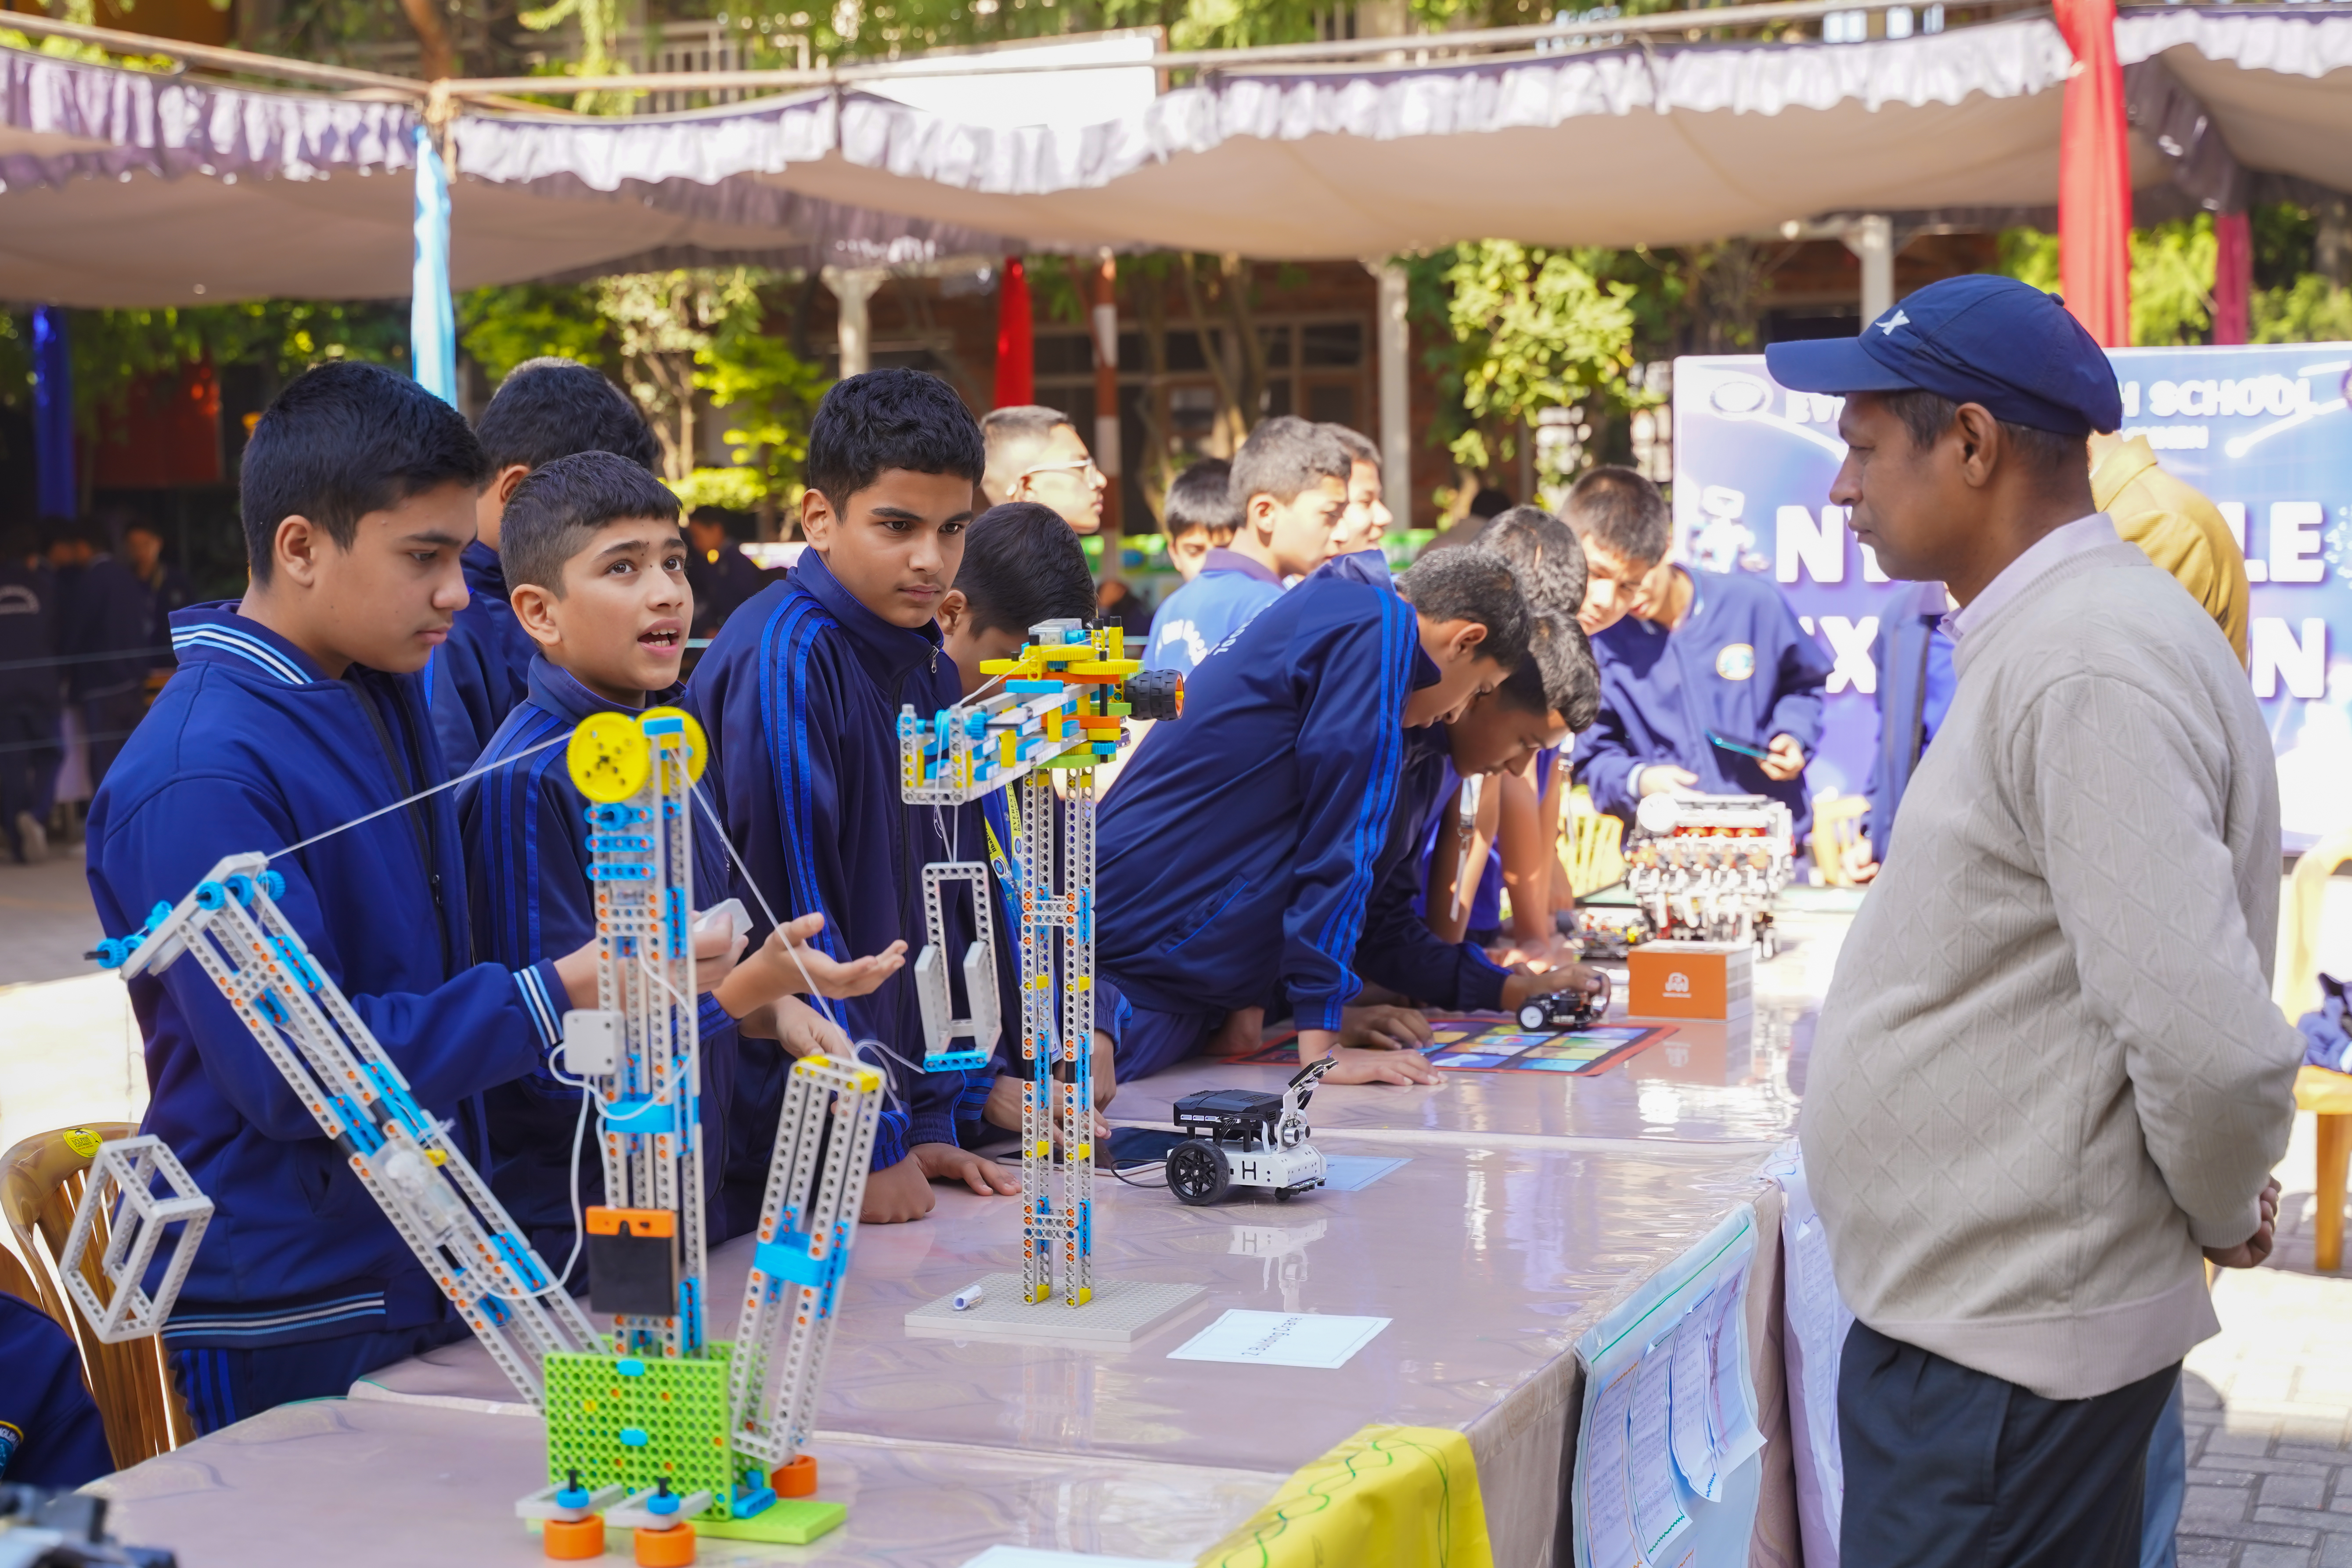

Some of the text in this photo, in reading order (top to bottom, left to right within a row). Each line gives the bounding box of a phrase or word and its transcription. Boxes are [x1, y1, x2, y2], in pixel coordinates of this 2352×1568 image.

[2149, 377, 2315, 417] SCHOOL
[2248, 618, 2325, 698] N
[1248, 1332, 1289, 1351] Building
[1273, 1318, 1302, 1331] Crane
